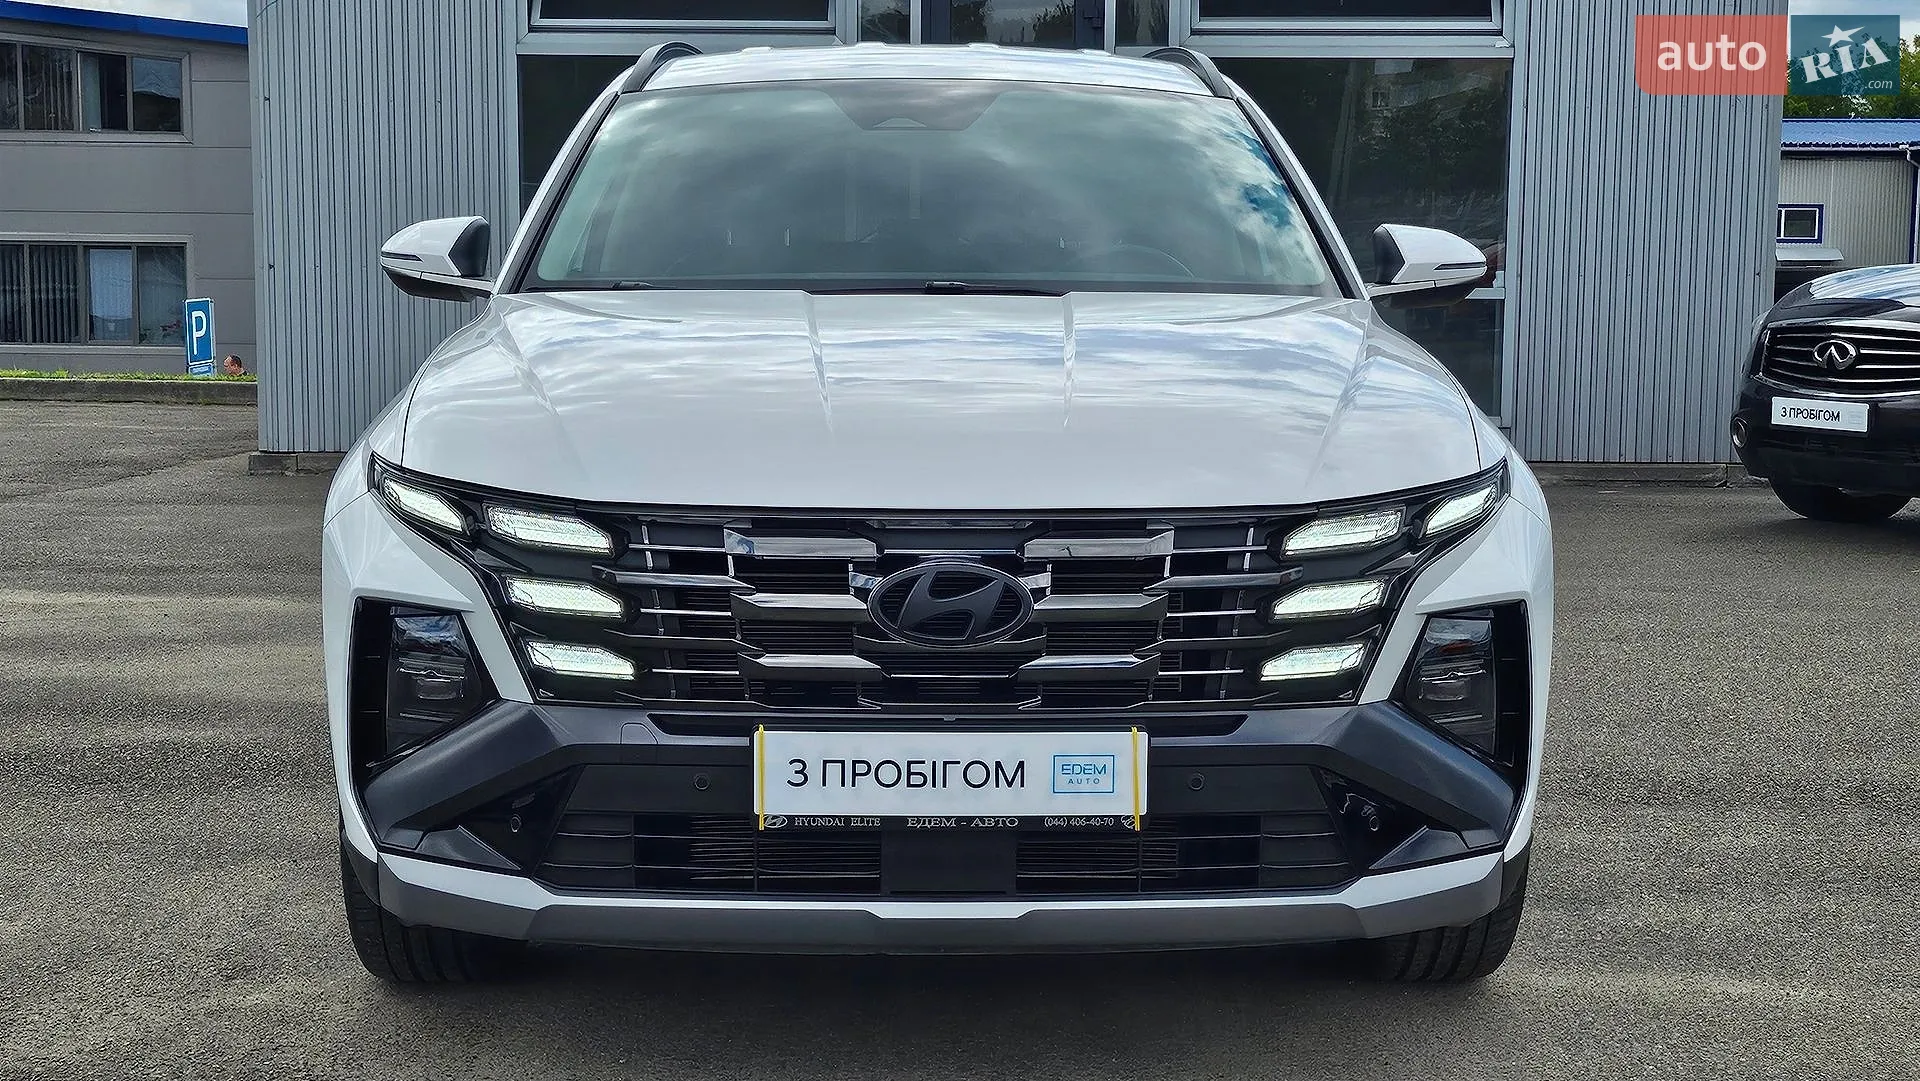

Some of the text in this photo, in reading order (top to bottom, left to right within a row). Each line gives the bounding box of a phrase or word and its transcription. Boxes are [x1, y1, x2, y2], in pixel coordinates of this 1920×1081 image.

[191, 310, 207, 355] P
[1789, 407, 1840, 422] ПРОБІГОМ
[821, 759, 1025, 788] ПРОБІГОМ
[1061, 763, 1107, 775] EDEM
[794, 817, 881, 827] HYUNDAI ELITE
[906, 817, 957, 828] ЕДЕМ
[970, 817, 1019, 827] АВТО
[1043, 816, 1115, 827] (044) 406-40-70
